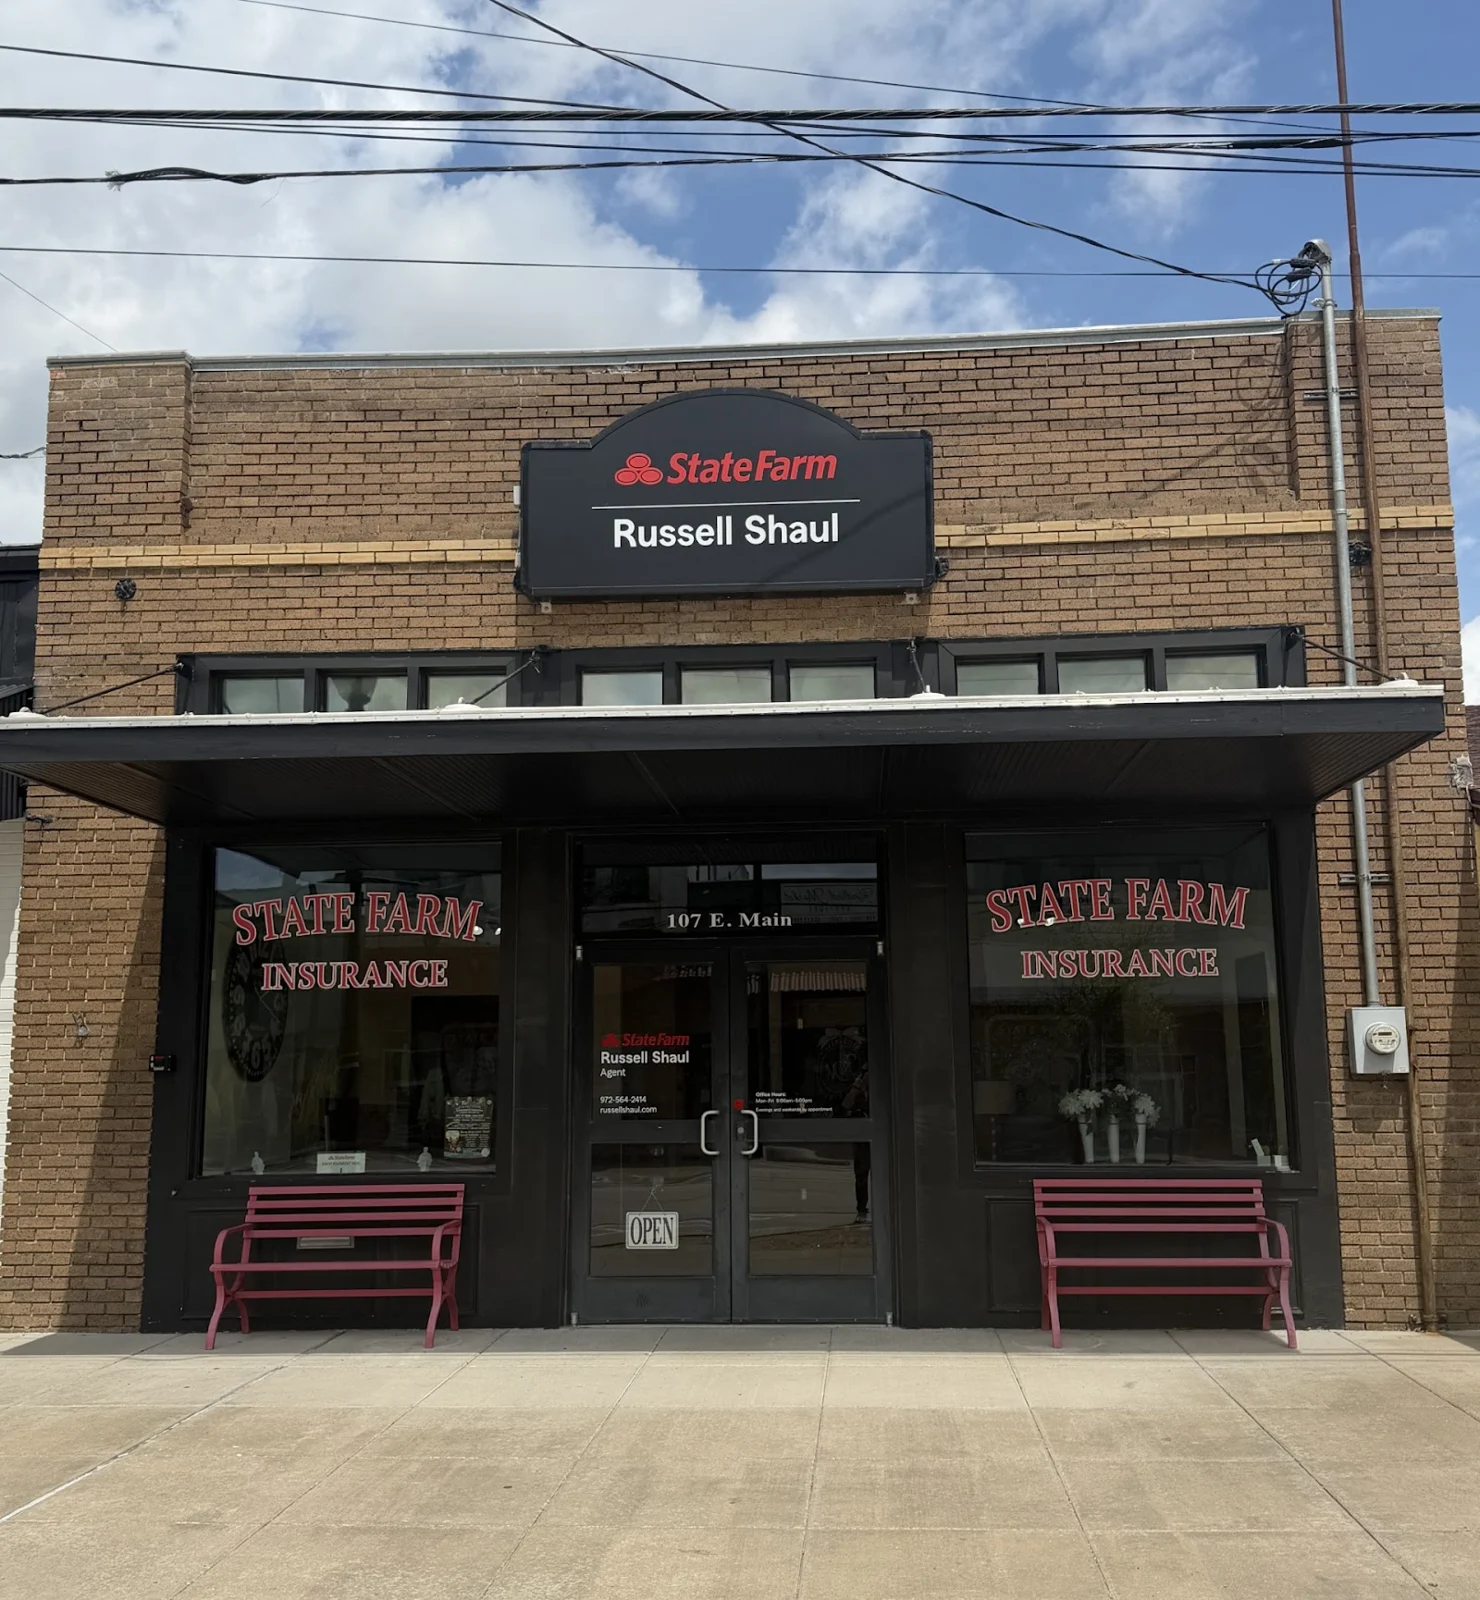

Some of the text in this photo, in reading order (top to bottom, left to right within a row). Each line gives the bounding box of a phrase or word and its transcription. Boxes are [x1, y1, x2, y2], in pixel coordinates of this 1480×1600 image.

[613, 512, 839, 548] Russell Shaul
[232, 892, 484, 946] STATE FARM
[986, 878, 1249, 932] STATE FARM
[667, 913, 702, 928] 107
[709, 912, 732, 928] E.
[738, 912, 792, 928] Main
[261, 959, 448, 991] INSURANCE
[1020, 948, 1219, 979] INSURANCE
[600, 1050, 690, 1064] Russell Shaul
[600, 1068, 626, 1079] Agent
[599, 1095, 647, 1104] 972-564-2414
[599, 1105, 658, 1114] russellshaul.com
[630, 1216, 674, 1245] OPEN
